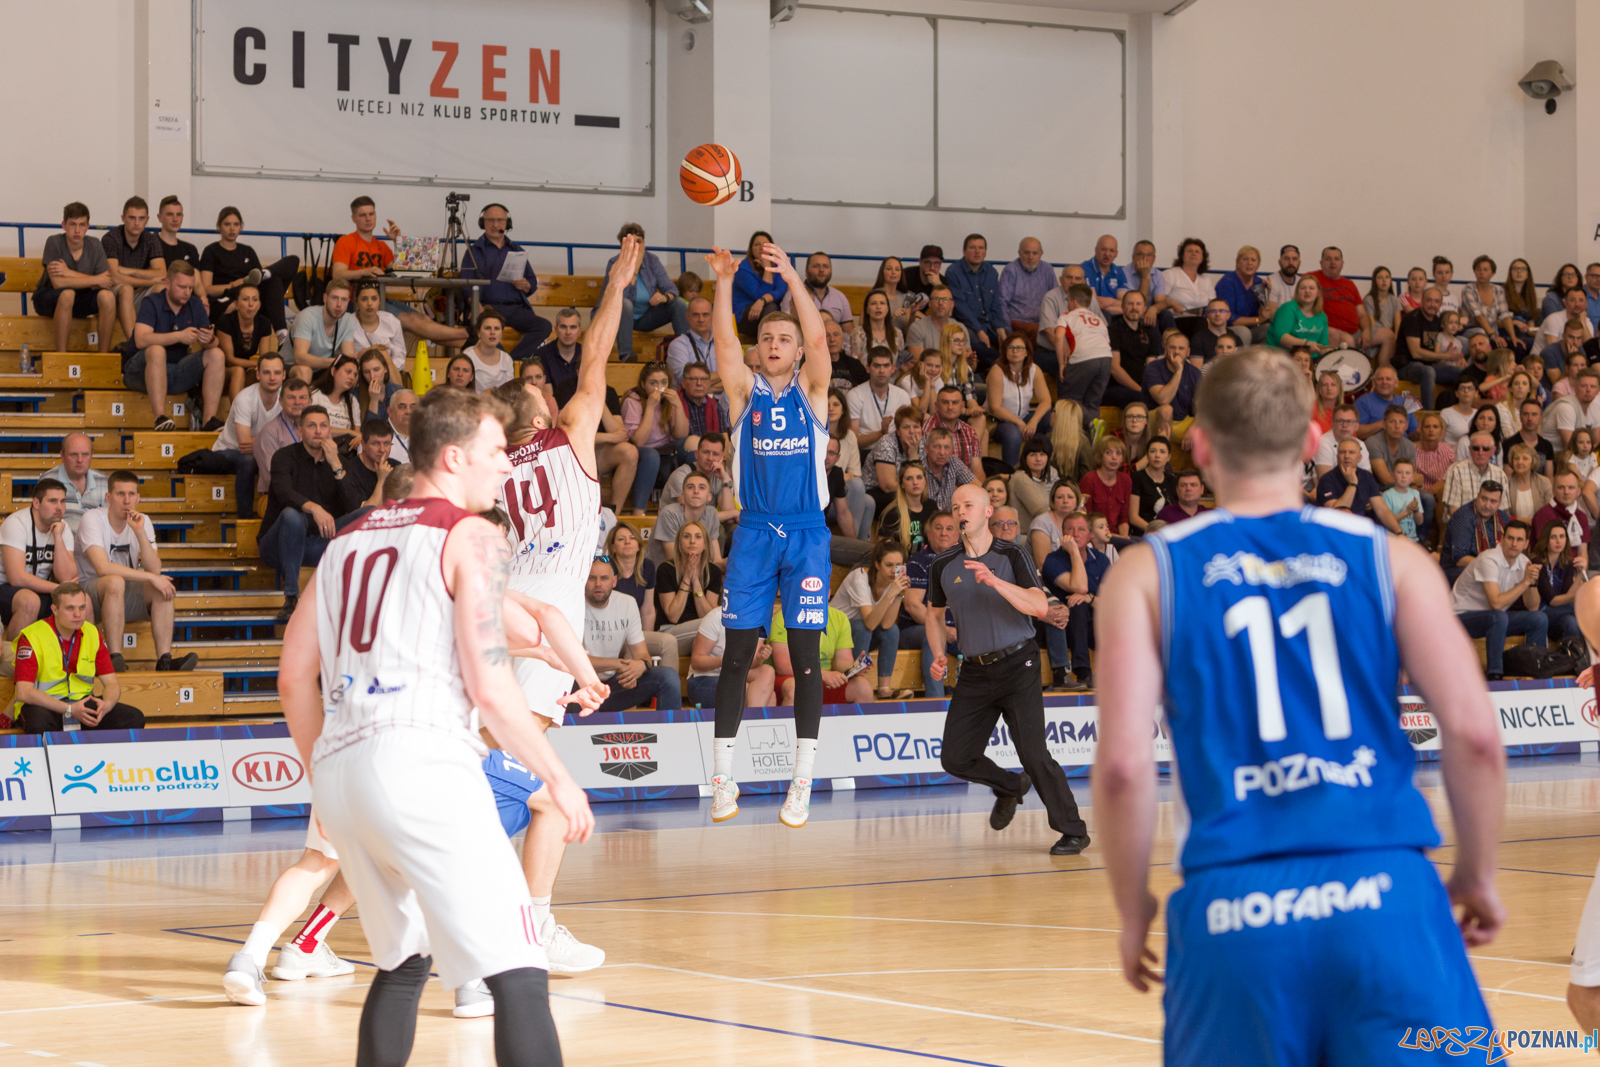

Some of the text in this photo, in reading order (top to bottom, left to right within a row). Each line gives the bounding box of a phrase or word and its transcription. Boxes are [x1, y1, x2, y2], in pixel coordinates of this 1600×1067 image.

[233, 26, 560, 106] CITYZEN
[337, 98, 561, 125] WIĘCEJ NIŻ KLUB SPORTOWY
[739, 180, 755, 203] B
[90, 334, 96, 343] 7
[72, 367, 78, 376] 8
[115, 404, 121, 414] 8
[176, 405, 182, 414] 7
[771, 407, 787, 431] 5
[752, 436, 809, 451] BIOFARM
[164, 446, 170, 455] 8
[215, 488, 221, 498] 8
[504, 465, 557, 543] 14
[643, 529, 649, 539] 2
[805, 580, 822, 589] KIA
[336, 546, 399, 658] 10
[800, 595, 824, 605] DELIK
[805, 611, 825, 624] PBG
[127, 635, 133, 646] 9
[1223, 592, 1352, 743] 11
[184, 690, 190, 701] 9
[1500, 704, 1575, 730] NICKEL
[603, 733, 646, 743] SECURITY
[603, 746, 652, 762] JOKER
[752, 754, 794, 768] HOTEL
[104, 759, 219, 785] funclub
[243, 760, 288, 783] KIA
[108, 781, 219, 793] biuro podróży
